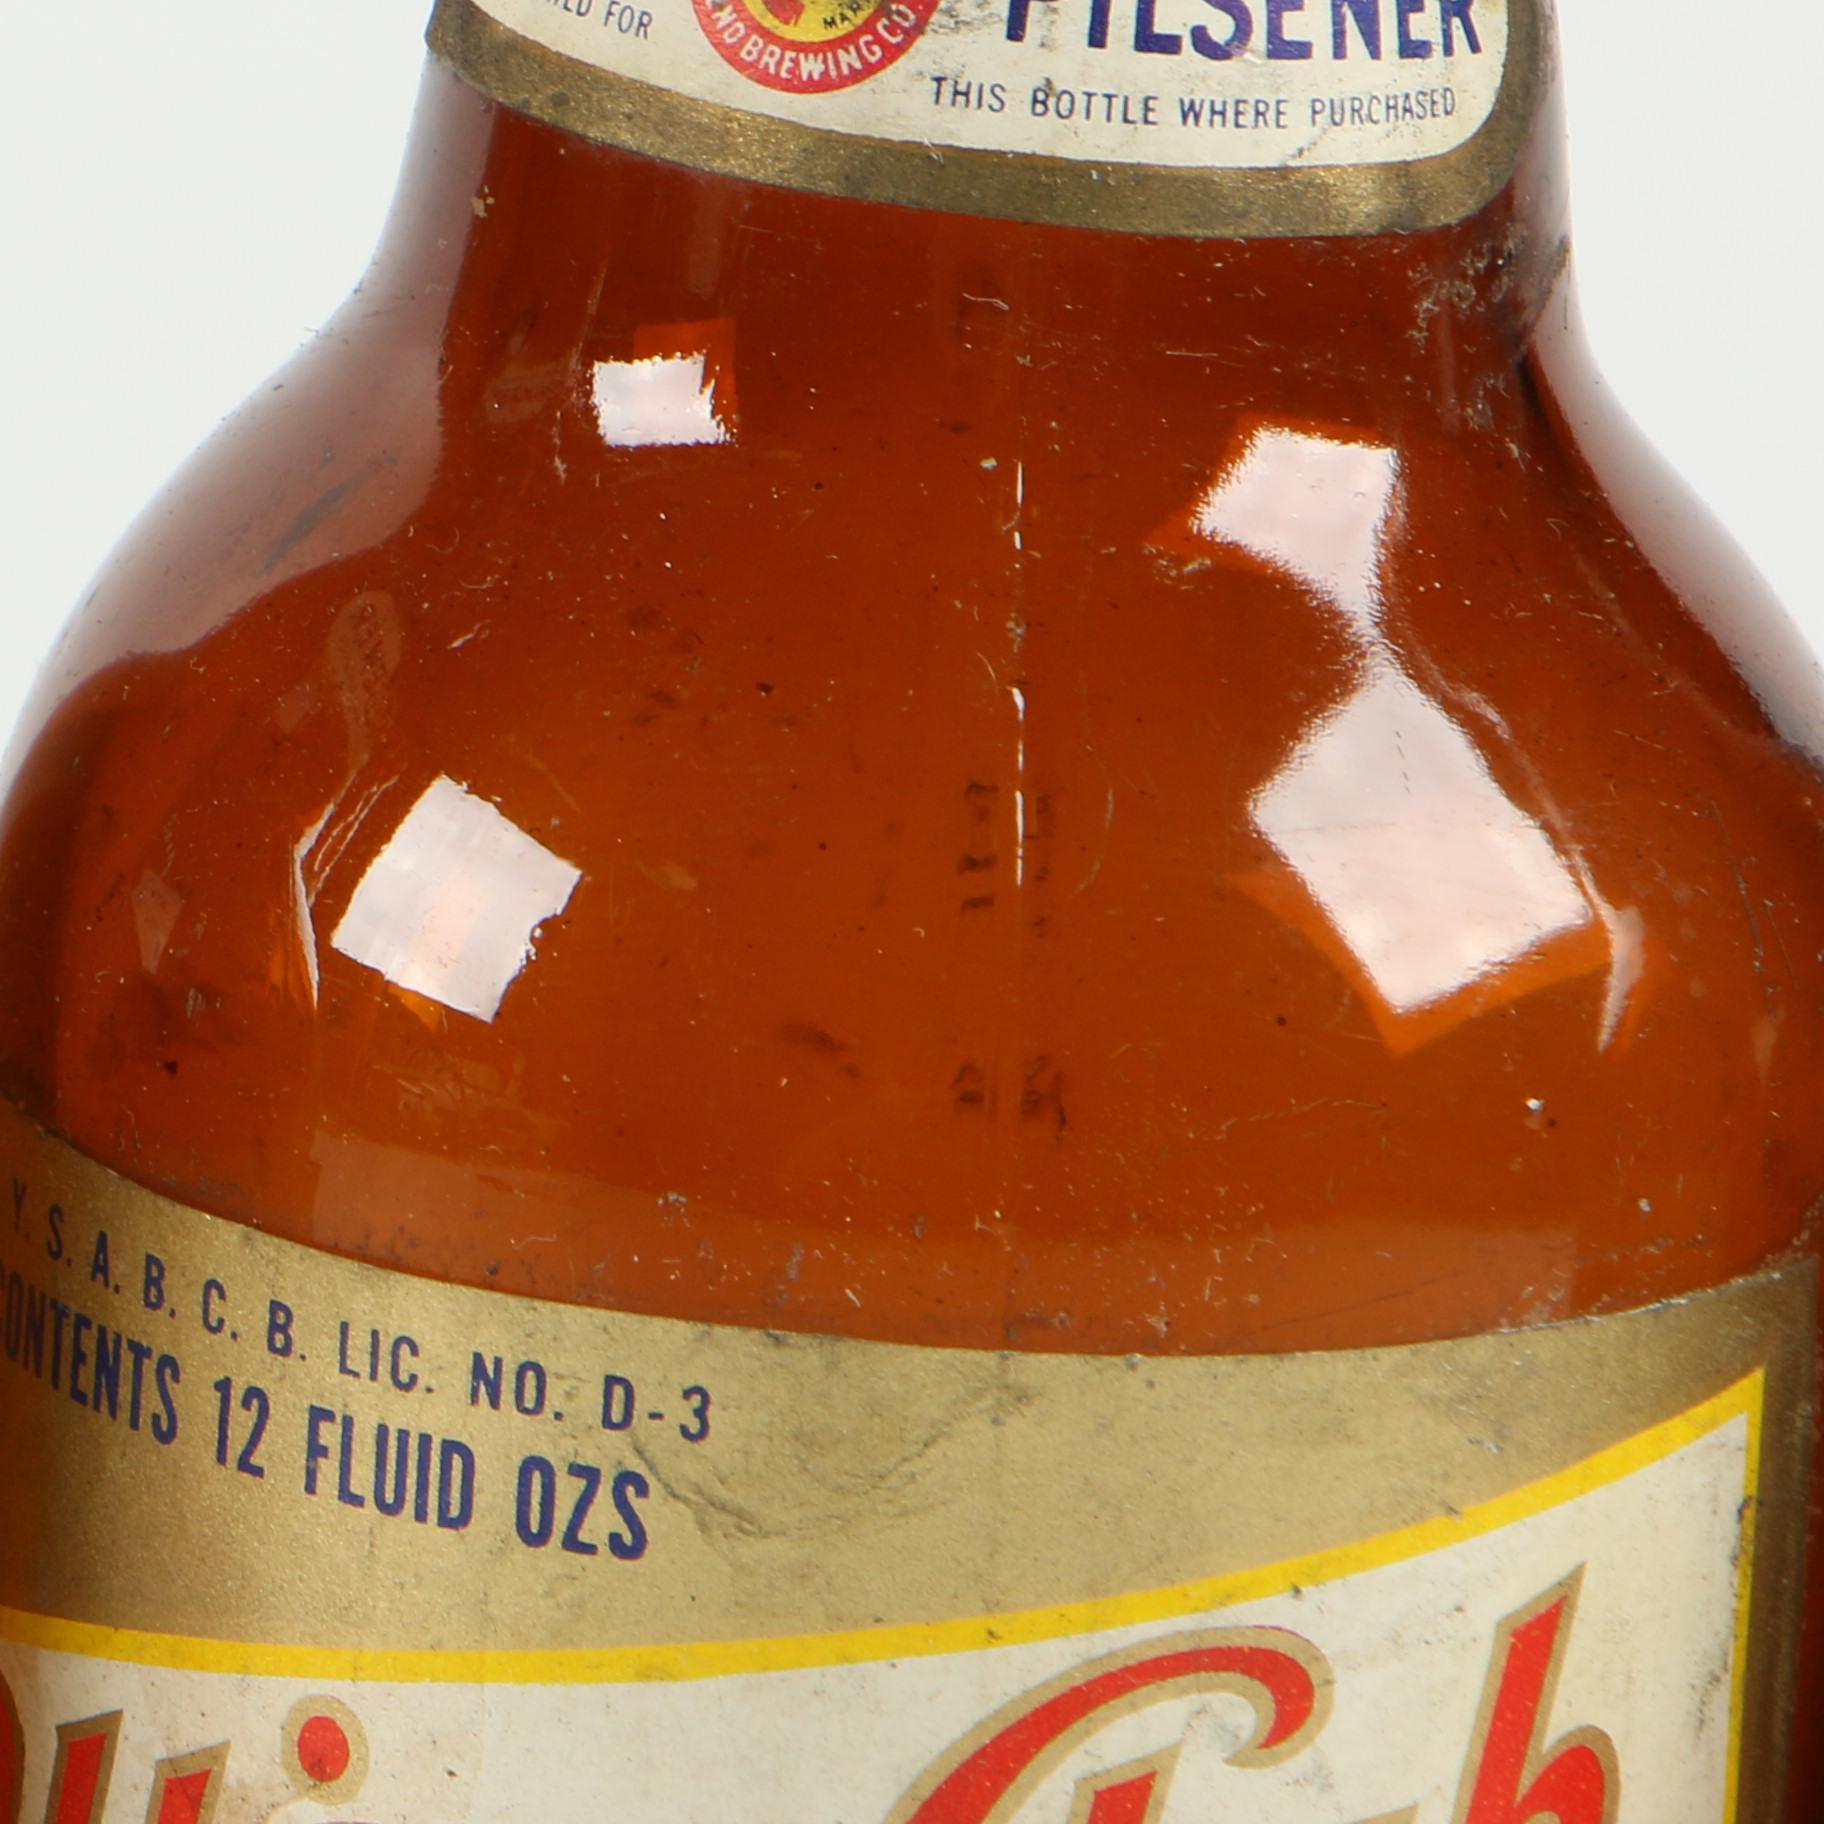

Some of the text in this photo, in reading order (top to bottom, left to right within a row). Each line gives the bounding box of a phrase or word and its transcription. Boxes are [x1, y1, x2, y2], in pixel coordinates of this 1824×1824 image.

[604, 0, 653, 39] FOR
[740, 35, 883, 81] BREWING
[931, 76, 1456, 129] THIS BOTTLE WHERE PURCHASED
[339, 1320, 435, 1394] LIC.
[470, 1351, 564, 1421] NO.
[601, 1374, 711, 1443] D-3
[213, 1376, 270, 1479] 12
[304, 1404, 476, 1531] FLUID
[516, 1455, 650, 1561] OZS
